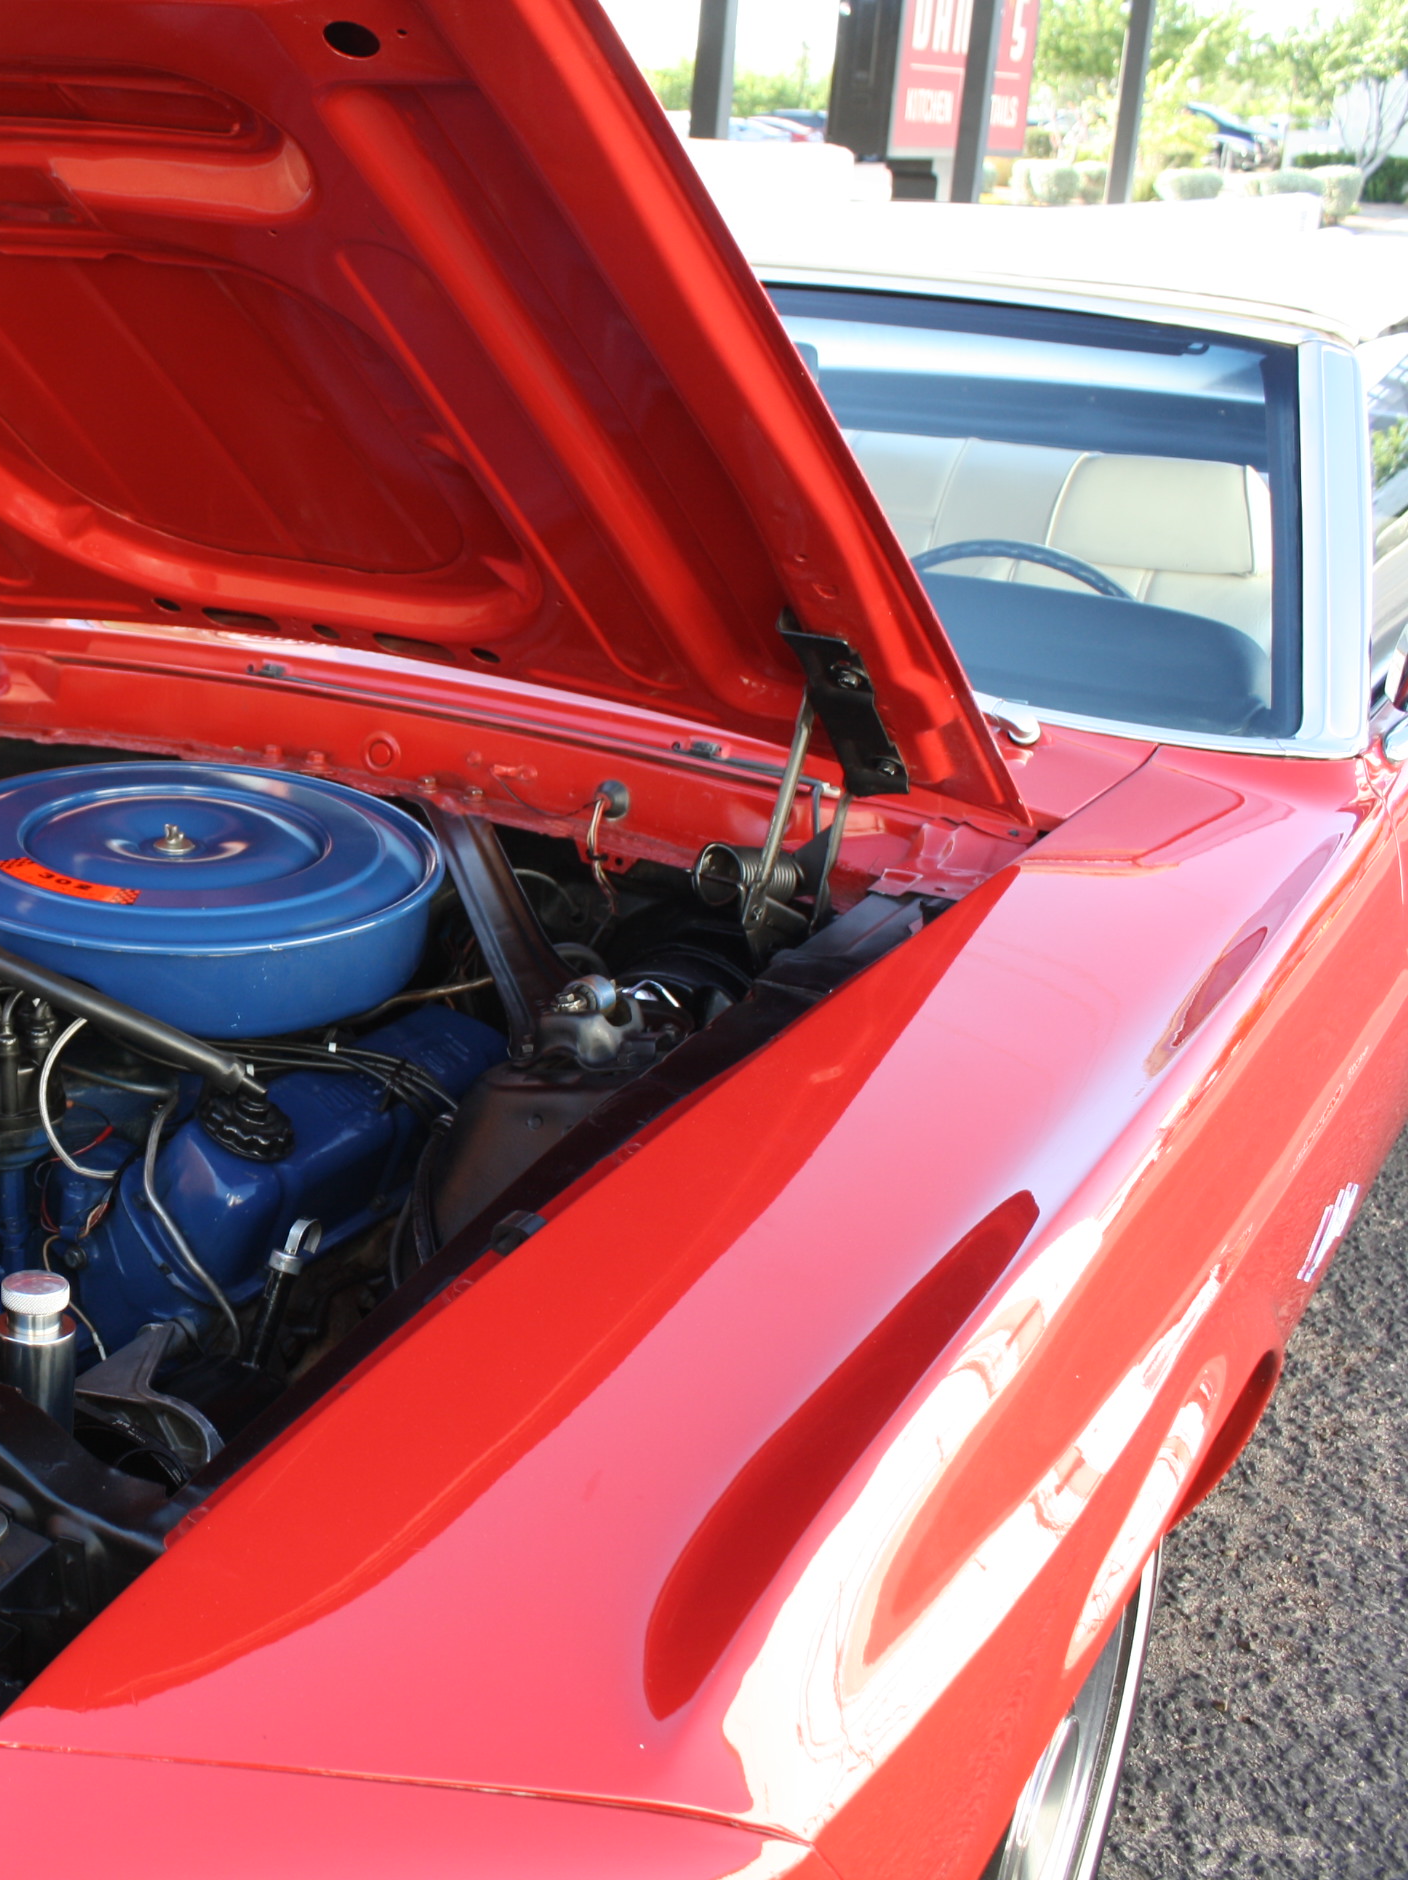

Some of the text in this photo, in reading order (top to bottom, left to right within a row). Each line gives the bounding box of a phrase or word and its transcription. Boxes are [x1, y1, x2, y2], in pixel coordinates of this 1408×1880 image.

[904, 87, 1020, 129] KITCHEN TAILS
[38, 872, 93, 891] 302
